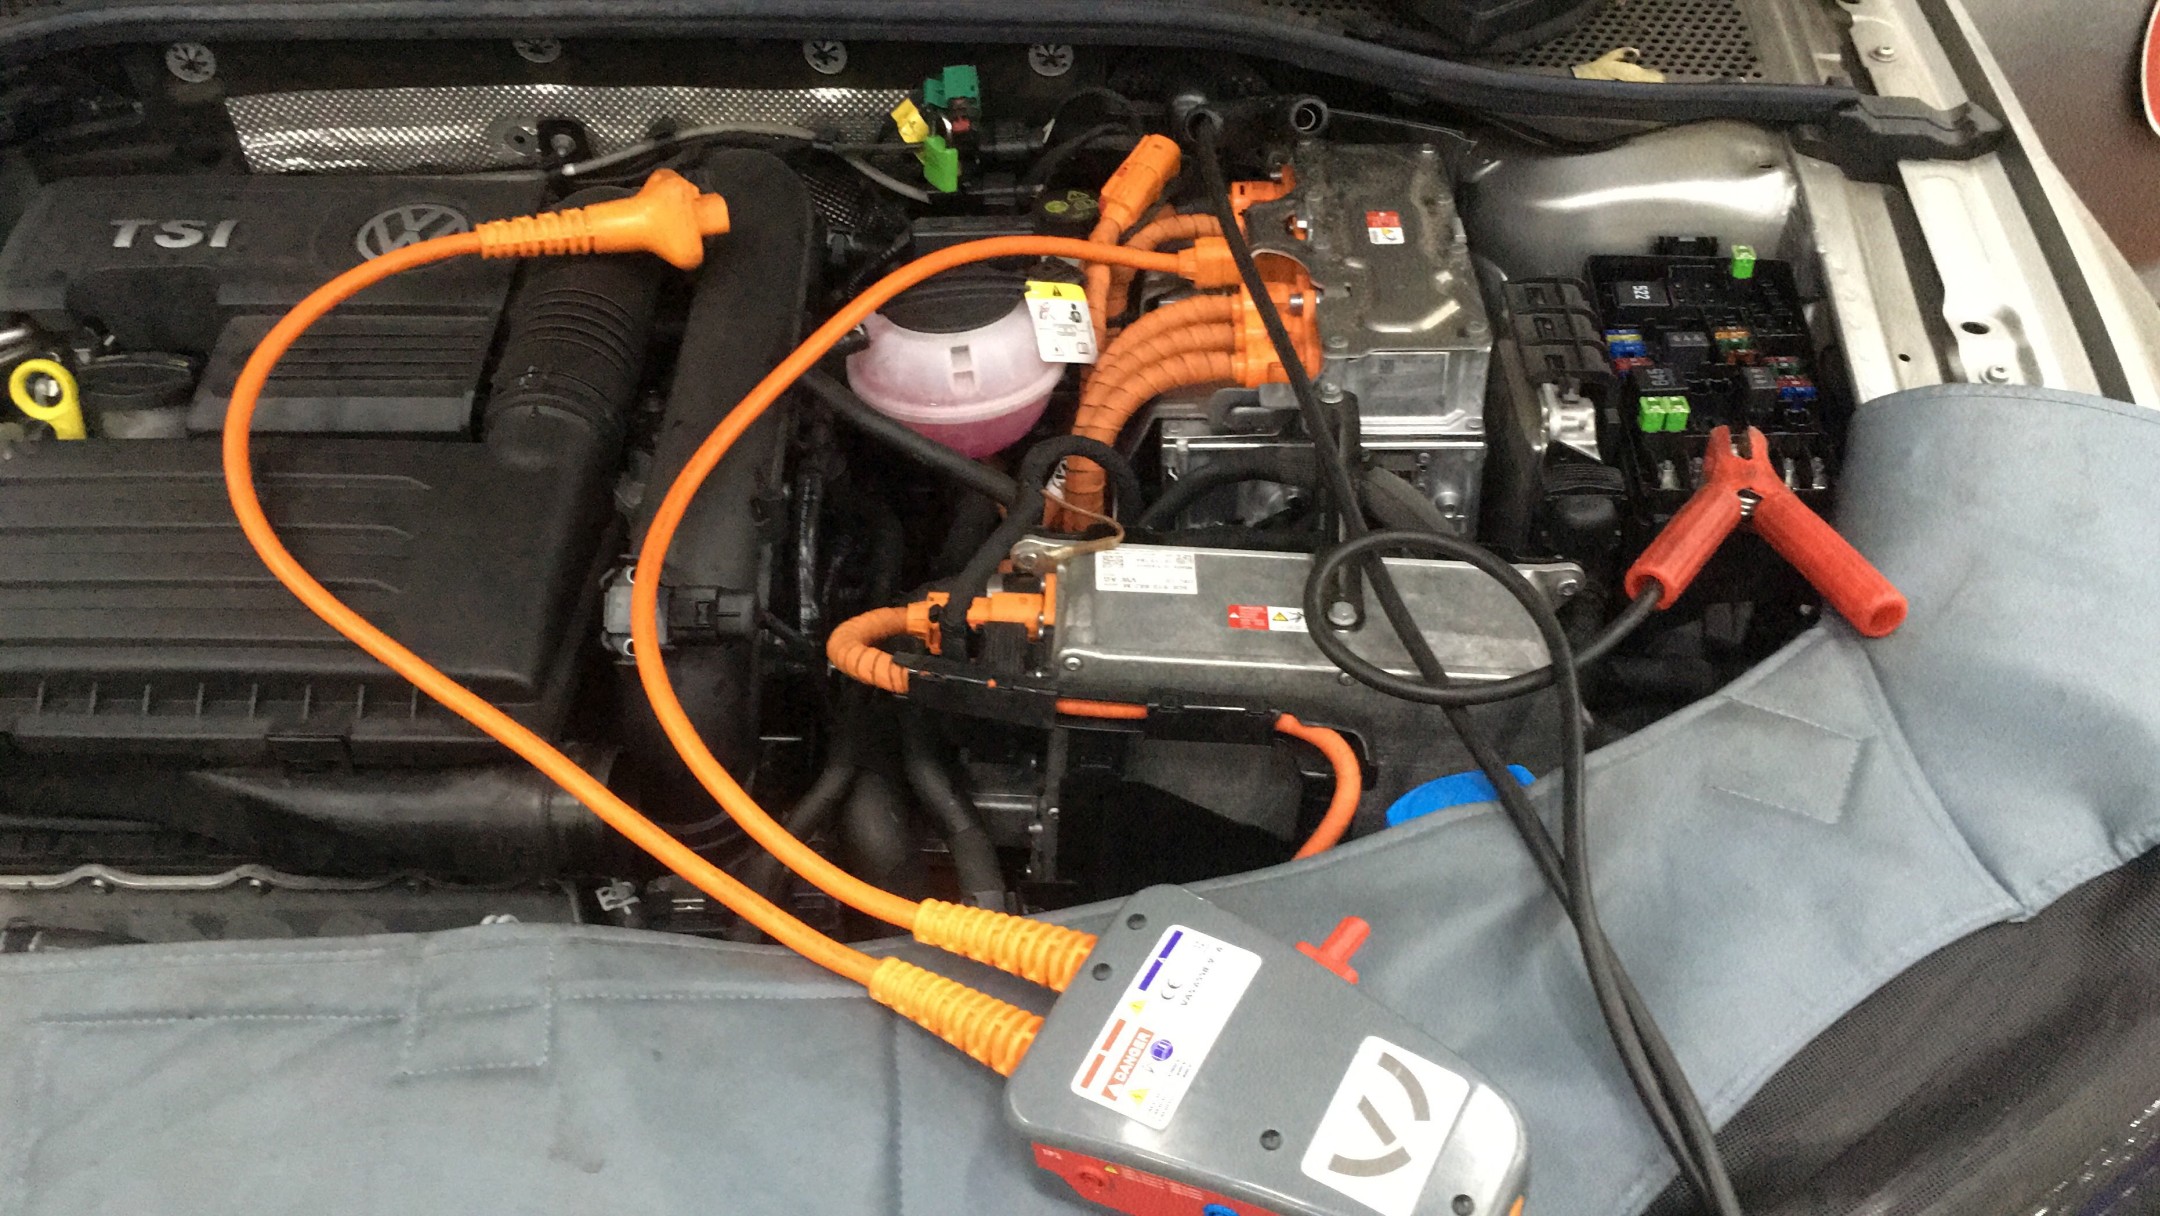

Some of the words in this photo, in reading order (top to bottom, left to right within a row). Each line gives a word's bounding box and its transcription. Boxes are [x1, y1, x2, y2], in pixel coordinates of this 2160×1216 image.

[110, 218, 239, 248] TSI
[1632, 285, 1651, 300] 522
[1114, 1030, 1151, 1081] DANGER
